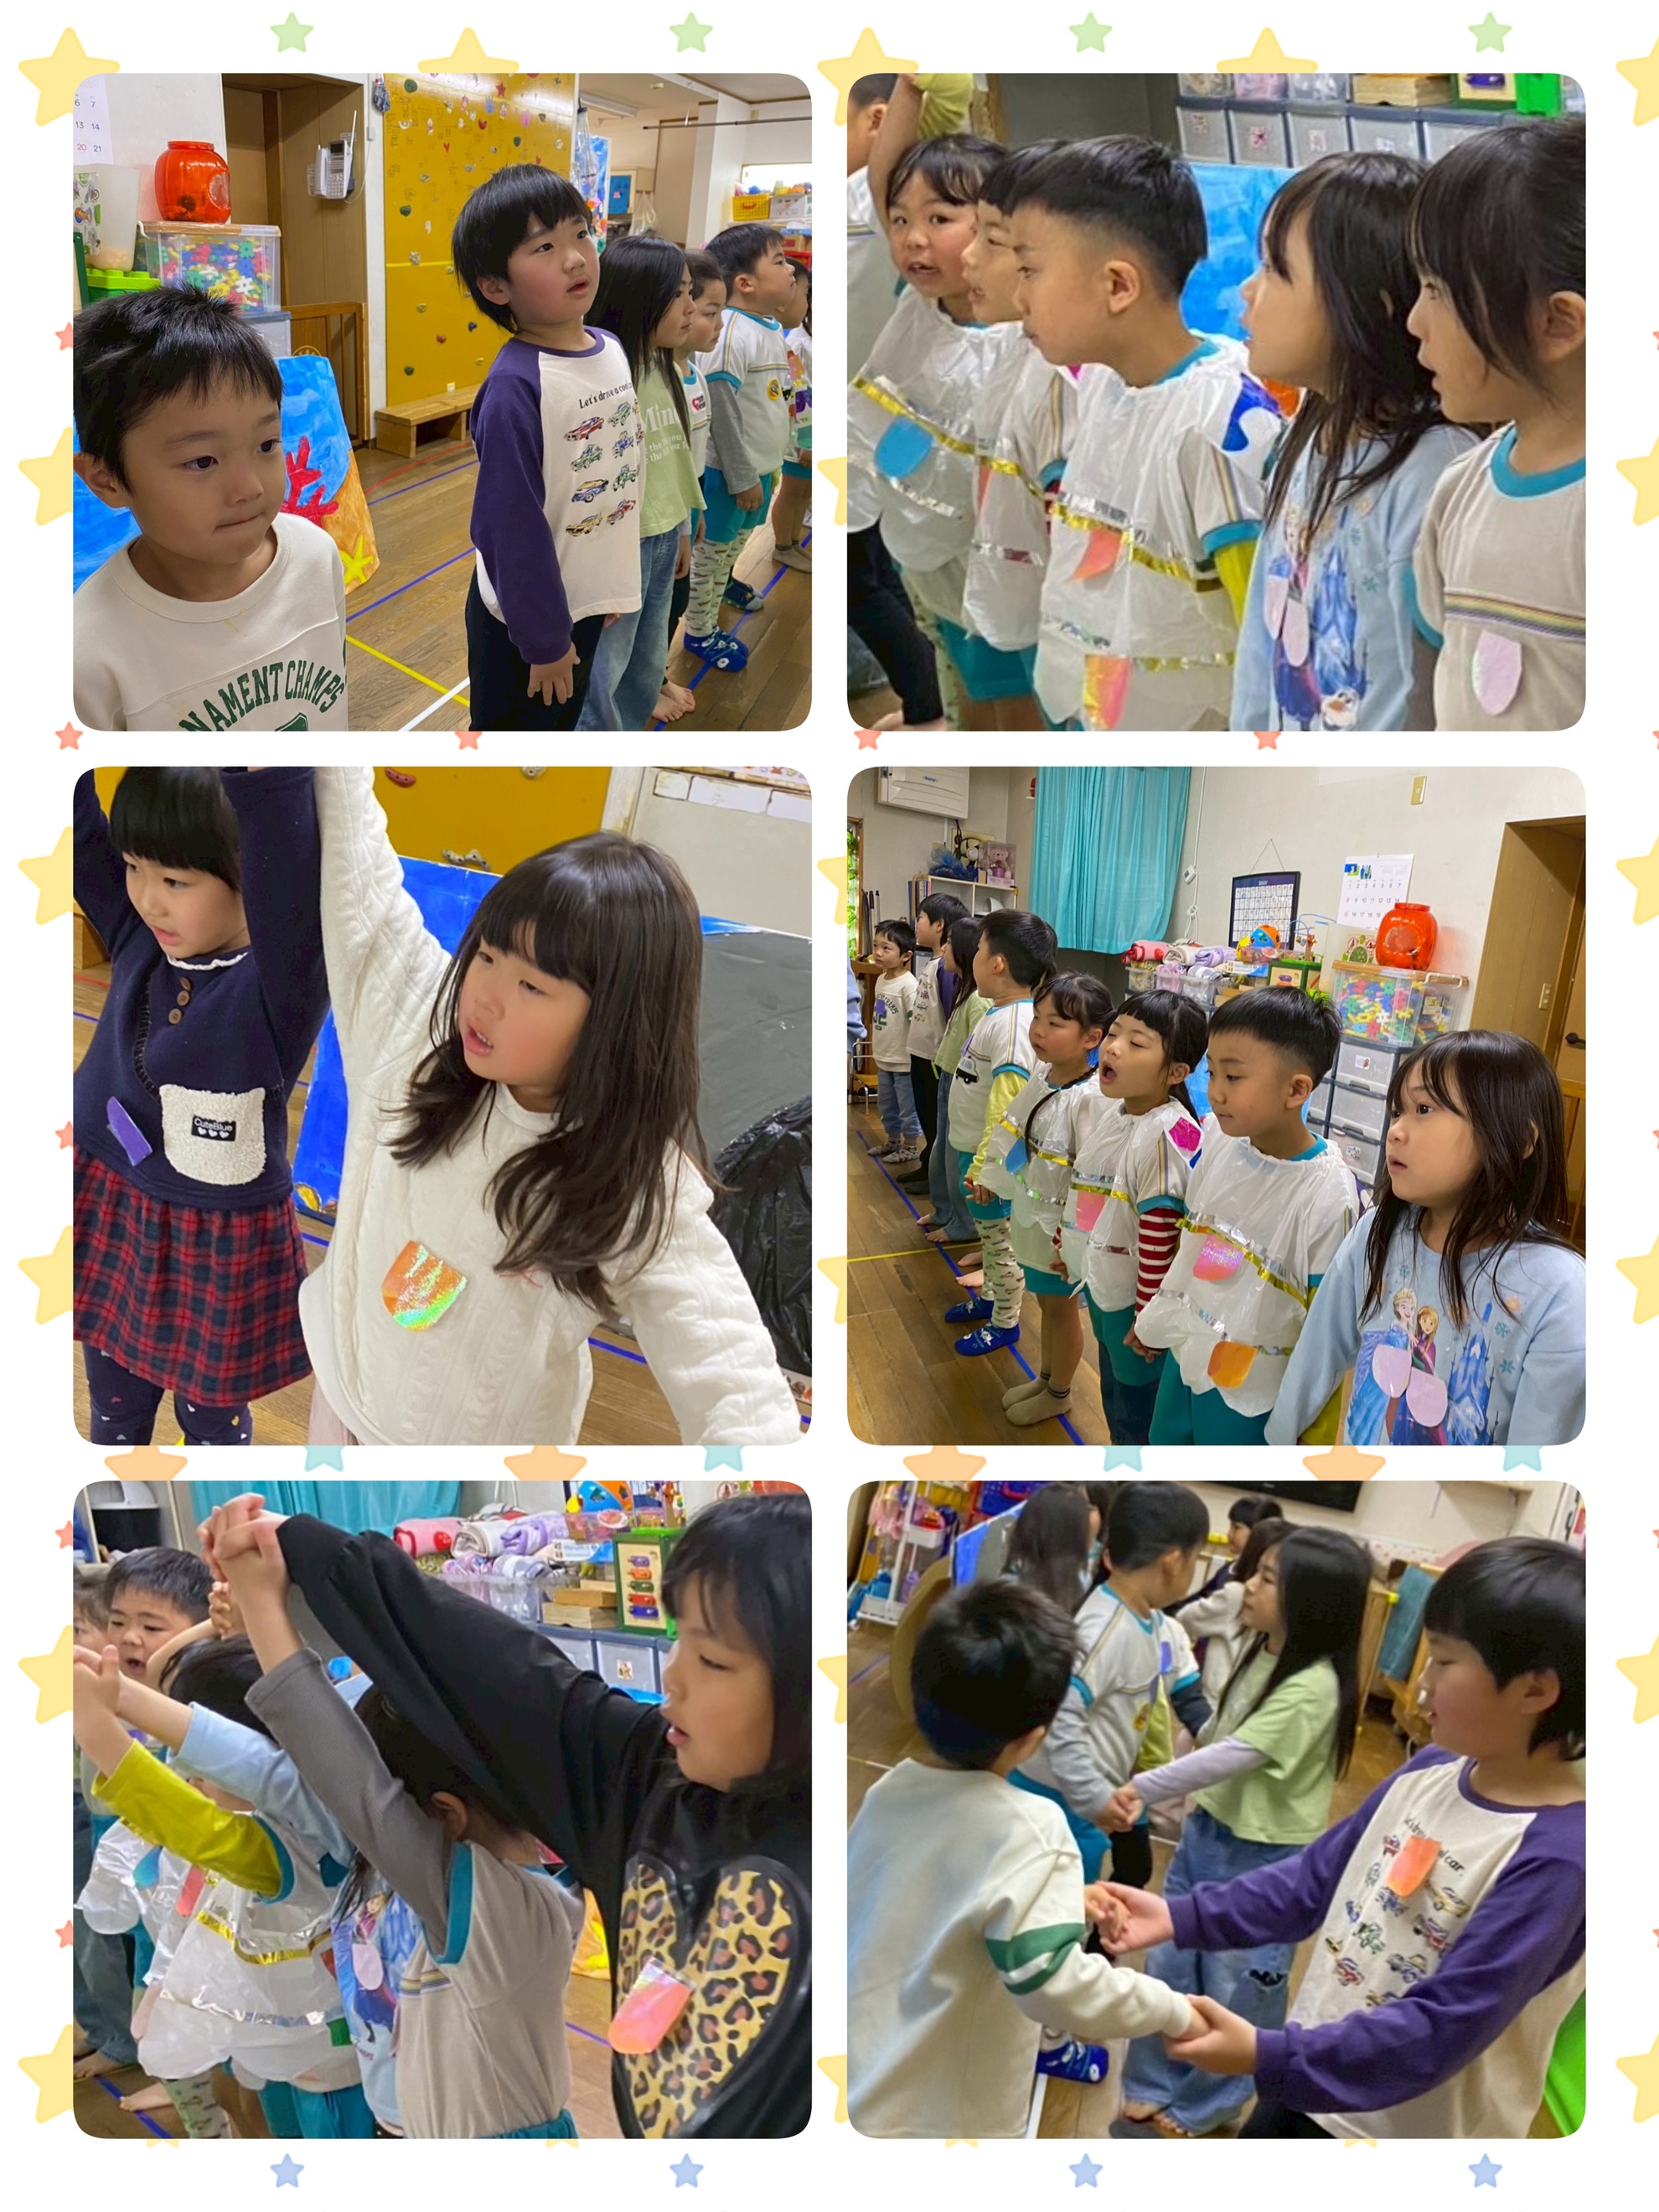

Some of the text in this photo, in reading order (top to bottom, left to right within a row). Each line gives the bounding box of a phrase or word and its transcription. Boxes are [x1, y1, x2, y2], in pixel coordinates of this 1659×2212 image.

[579, 395, 597, 409] Let's
[285, 660, 344, 713] CHAMPS
[194, 1118, 233, 1132] CuteBlue
